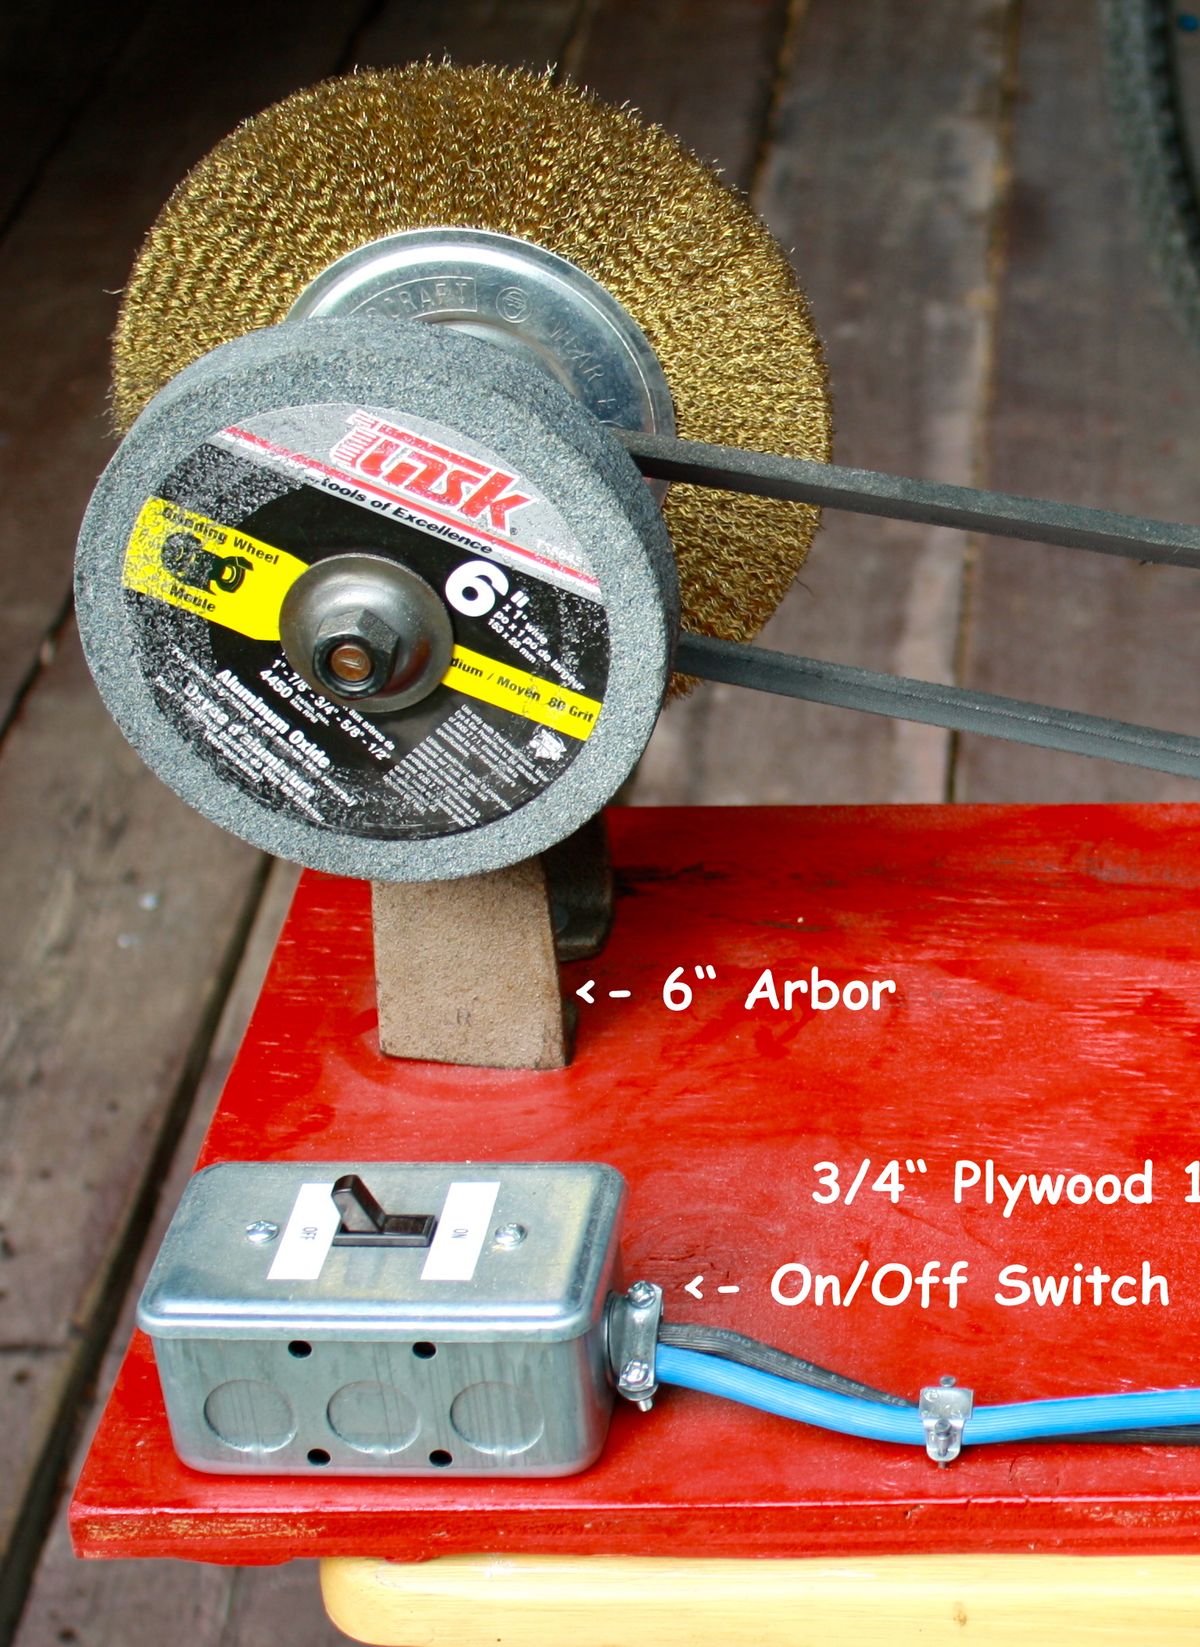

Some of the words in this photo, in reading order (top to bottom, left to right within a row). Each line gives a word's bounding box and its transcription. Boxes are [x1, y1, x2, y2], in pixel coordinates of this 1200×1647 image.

[321, 478, 366, 502] tools
[371, 499, 392, 512] of
[393, 506, 493, 553] Excellence
[234, 537, 279, 565] Wheel
[525, 623, 548, 644] wide
[494, 611, 509, 624] po
[551, 659, 585, 691] largeur
[508, 637, 521, 649] 25
[520, 647, 536, 664] mm
[261, 670, 292, 697] 4450
[451, 658, 483, 678] dium
[497, 676, 541, 700] Moyen
[569, 707, 595, 723] Grit
[217, 671, 288, 732] Aluminum
[289, 731, 329, 767] Oxide
[300, 1226, 317, 1239] OFF
[450, 1228, 467, 1238] ON
